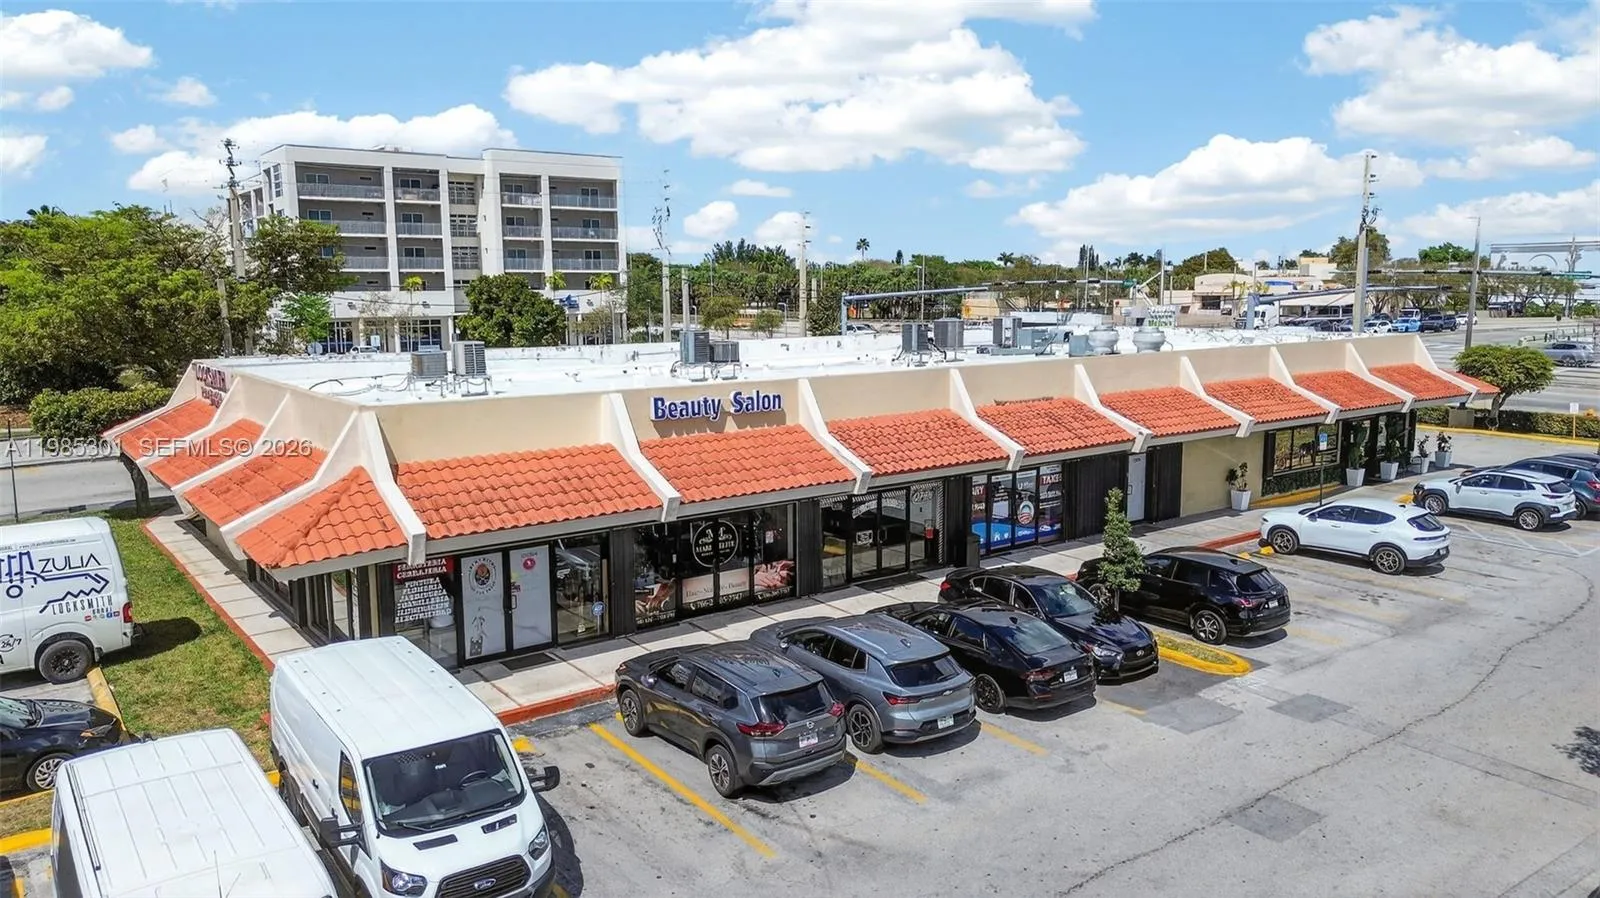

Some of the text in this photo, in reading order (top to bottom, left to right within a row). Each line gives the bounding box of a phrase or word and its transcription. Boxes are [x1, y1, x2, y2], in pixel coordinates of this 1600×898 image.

[651, 390, 782, 420] Beauty Salon
[38, 553, 102, 574] ZULIA
[51, 595, 113, 615] LOCKSMITH
